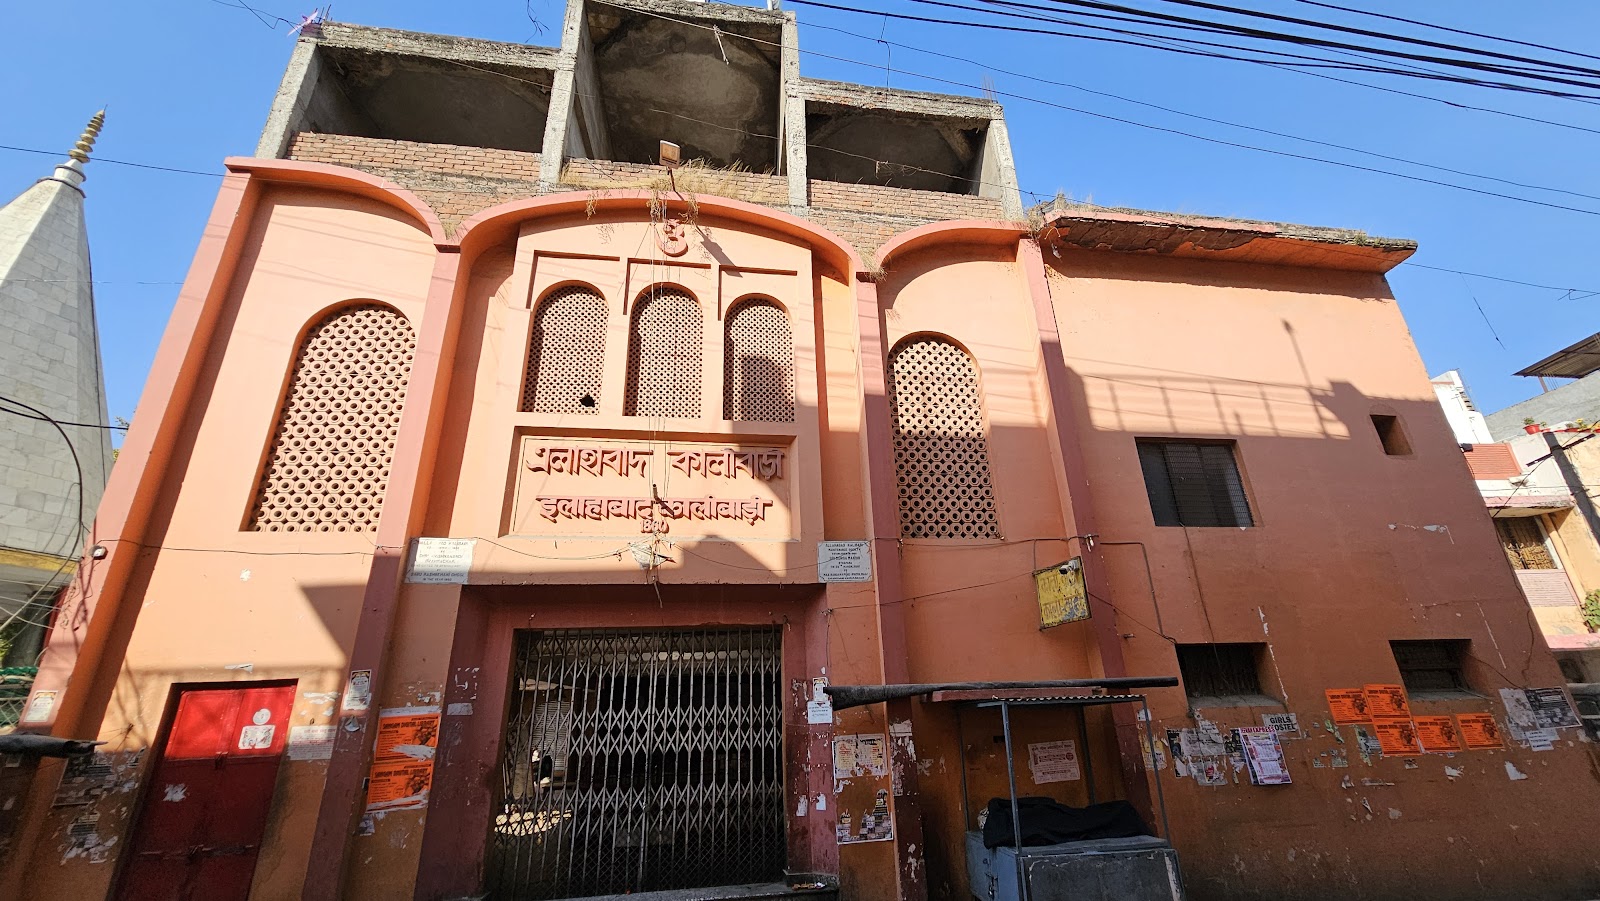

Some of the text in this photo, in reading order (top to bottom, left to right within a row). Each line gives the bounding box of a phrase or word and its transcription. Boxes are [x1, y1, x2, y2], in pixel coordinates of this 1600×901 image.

[526, 446, 654, 479] এলাহাবাদ
[535, 495, 653, 524] इलाहाबाद
[1268, 723, 1296, 731] OSTEL
[1270, 716, 1291, 724] GIRLS
